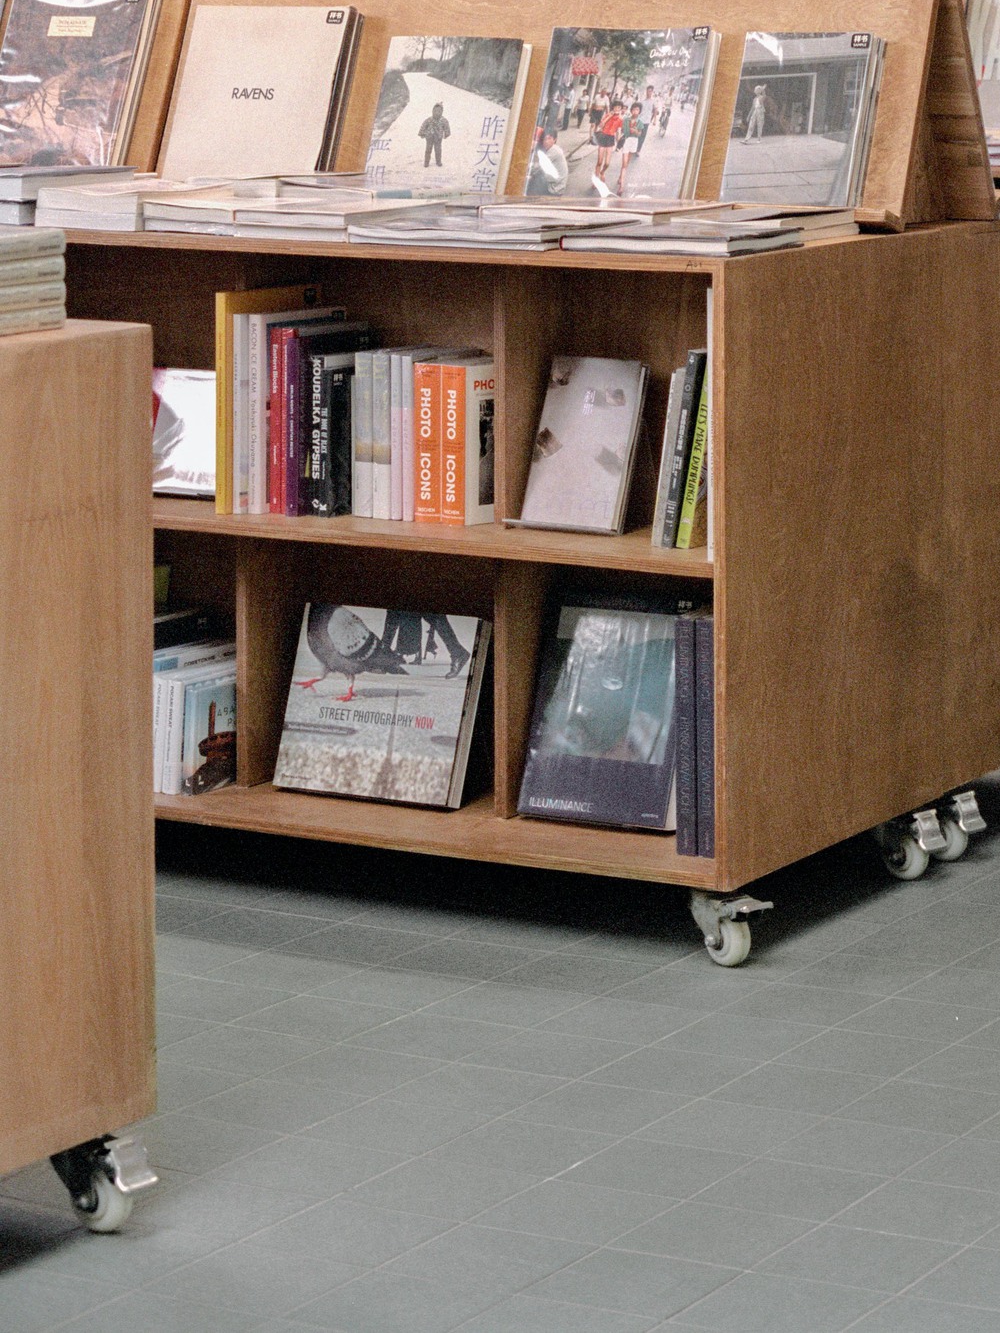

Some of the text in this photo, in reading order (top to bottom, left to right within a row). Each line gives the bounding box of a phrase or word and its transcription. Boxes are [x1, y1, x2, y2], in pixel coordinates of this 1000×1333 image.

[231, 87, 275, 101] RAVENS
[469, 115, 505, 193] 昨天堂
[271, 344, 279, 394] Eastern Blocks
[311, 359, 322, 480] KOUDELKA GYPSIES
[697, 403, 709, 426] LET'S
[420, 387, 431, 500] PHOTO ICONS
[445, 389, 457, 503] PHOTO ICONS
[693, 427, 706, 453] MAKE
[318, 706, 435, 730] STREET PHOTOGRAPHY NOW
[528, 797, 594, 813] ILLUMINANCE
